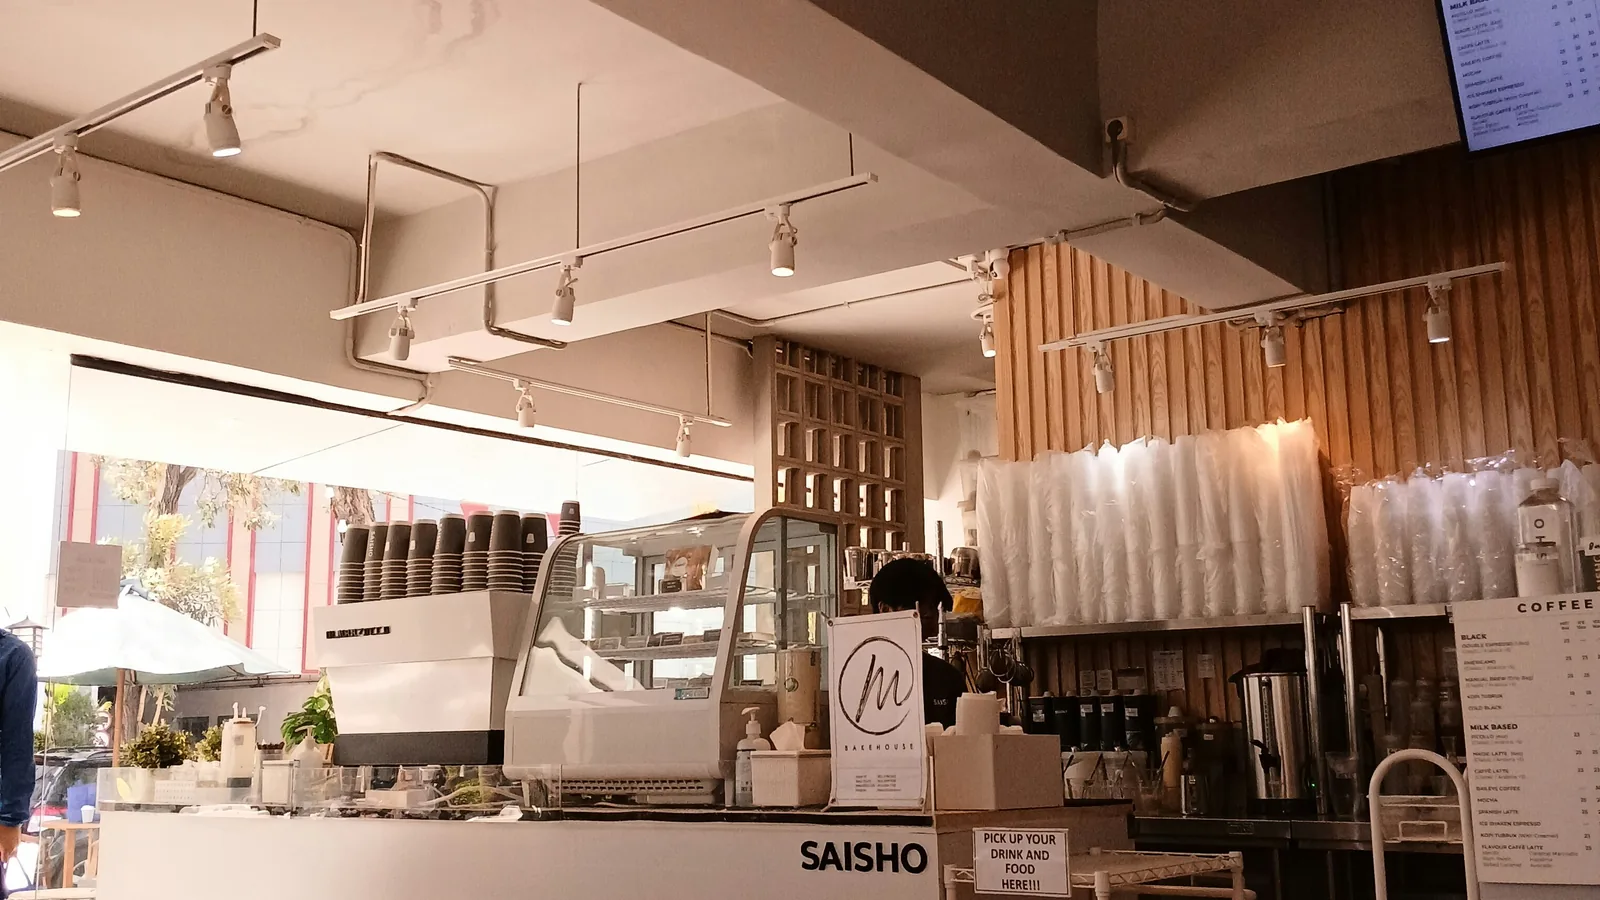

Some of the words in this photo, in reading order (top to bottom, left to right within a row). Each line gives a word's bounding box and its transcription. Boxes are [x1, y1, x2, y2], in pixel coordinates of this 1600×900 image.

[1517, 599, 1594, 614] COFFEE
[1461, 633, 1487, 641] BLACK
[844, 742, 915, 752] BAKEHOUSE
[983, 832, 1006, 844] PICK
[1008, 833, 1024, 844] UP
[1026, 834, 1056, 846] YOUR
[800, 840, 928, 874] SAISHO
[990, 848, 1023, 860] DRINK
[1025, 850, 1050, 860] AND
[1005, 863, 1036, 875] FOOD
[1001, 878, 1041, 891] HERE!!!
